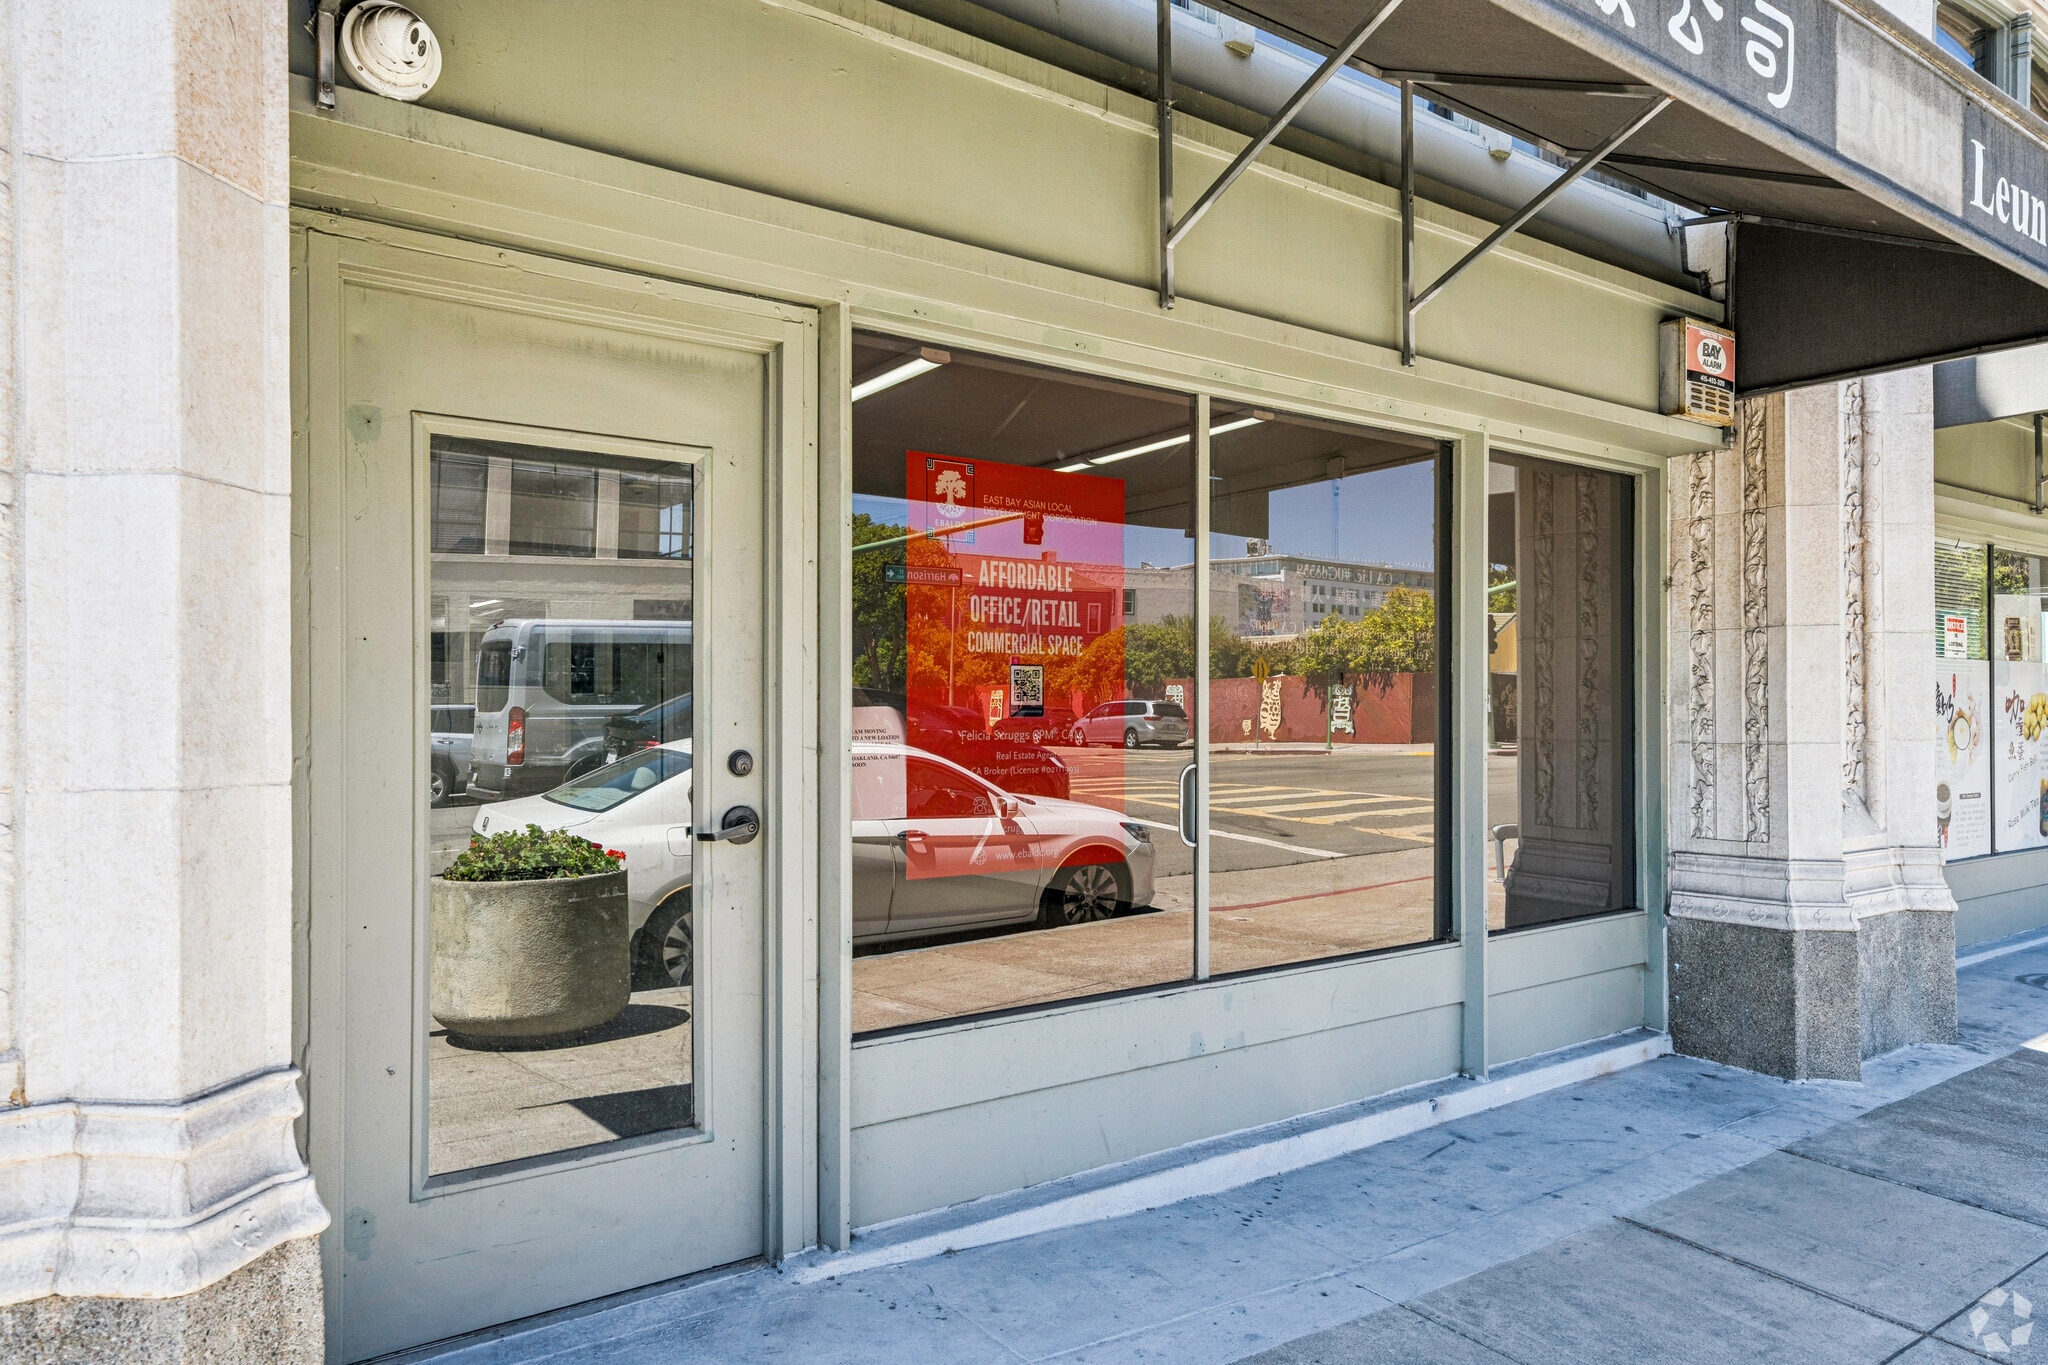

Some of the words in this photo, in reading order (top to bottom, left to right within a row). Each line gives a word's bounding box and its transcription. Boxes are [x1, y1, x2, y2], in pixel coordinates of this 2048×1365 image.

[1970, 138, 2047, 247] Leun
[1702, 342, 1721, 360] BAY
[1702, 359, 1722, 371] ALARM
[983, 494, 1003, 505] EAST
[1005, 497, 1022, 507] BAY
[1023, 499, 1046, 510] ASIAN
[1047, 502, 1072, 513] LOCAL
[935, 518, 967, 530] EBALDC
[1043, 514, 1097, 526] CORPORATION
[978, 560, 1073, 593] AFFORDABLE
[970, 595, 1081, 627] OFFICE/RETAIL
[968, 631, 1045, 655] COMMERCIAL
[1047, 635, 1083, 656] SPACE
[961, 730, 991, 741] Felicia
[993, 730, 1029, 743] Scruggs
[996, 752, 1011, 760] Real
[1013, 751, 1035, 760] Estate
[971, 767, 982, 776] CA
[984, 767, 1008, 776] Broker
[1010, 766, 1040, 777] (License
[995, 847, 1059, 860] www.ebaldc.org
